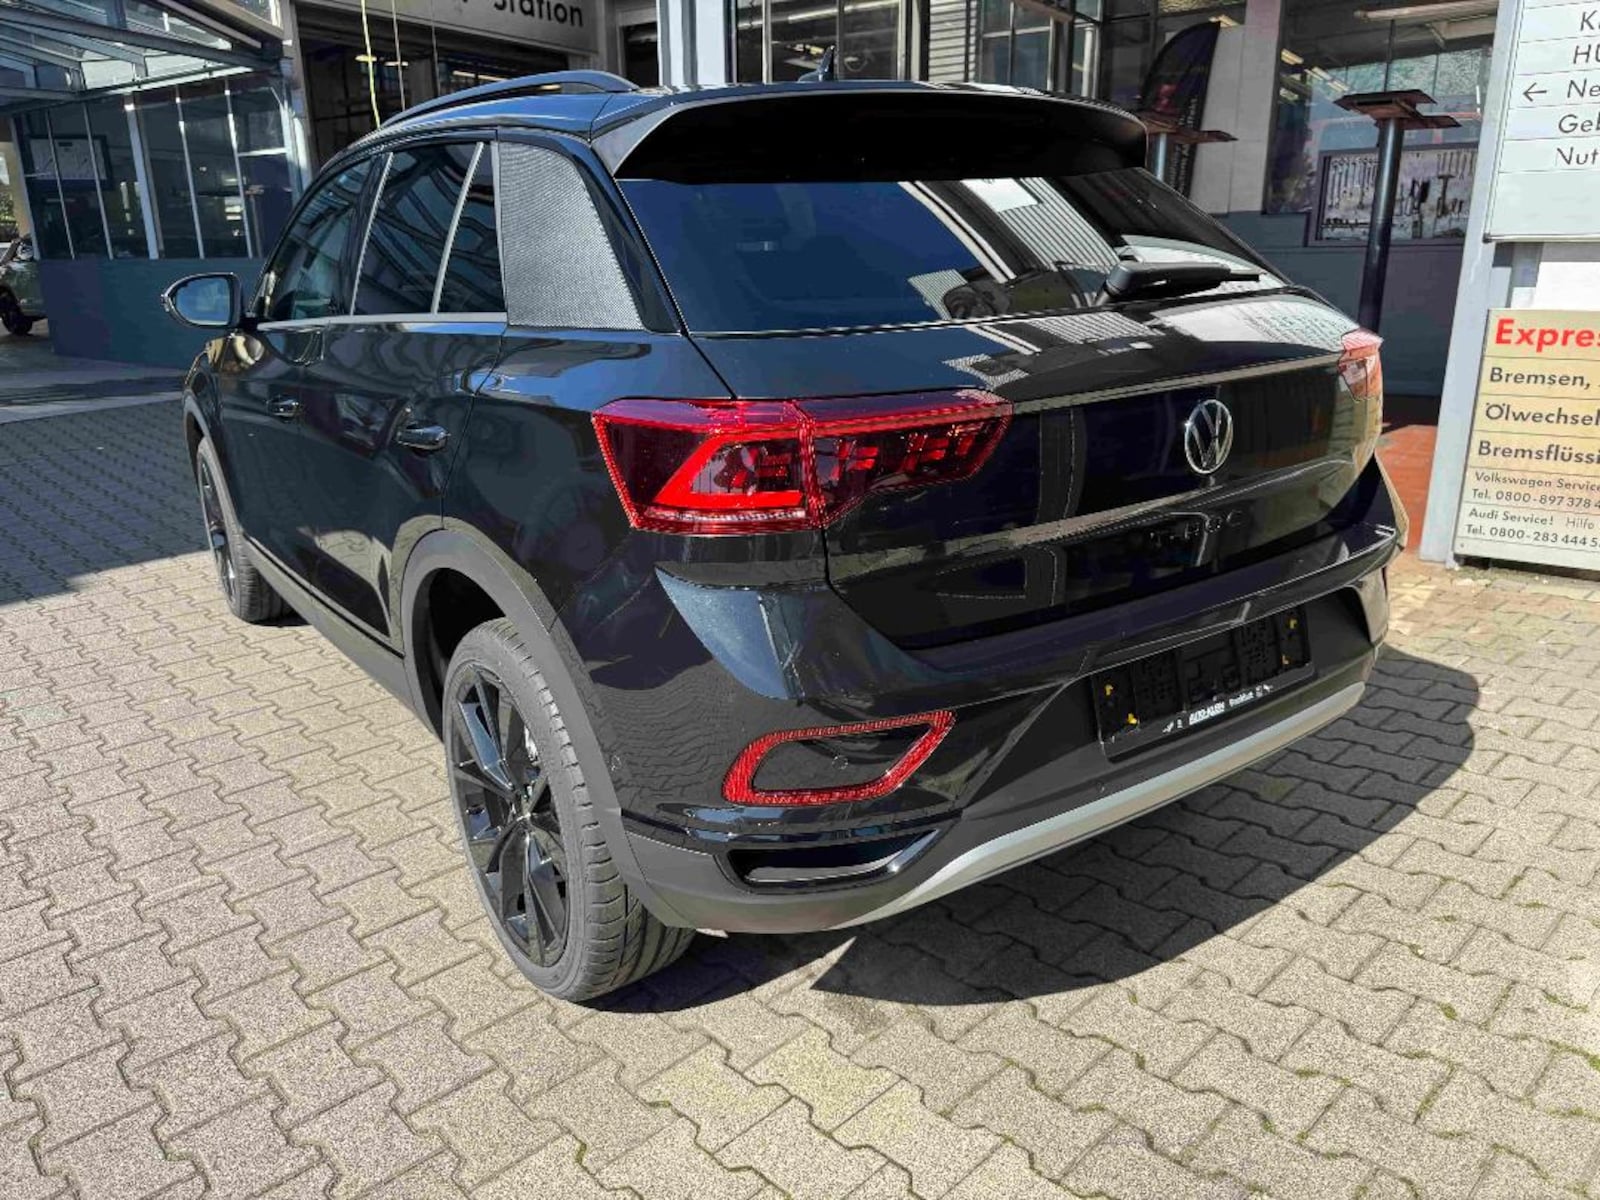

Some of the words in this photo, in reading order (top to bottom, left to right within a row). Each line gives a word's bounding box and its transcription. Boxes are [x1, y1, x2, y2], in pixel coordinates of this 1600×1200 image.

[1580, 10, 1600, 31] K
[1494, 318, 1600, 352] Expre
[1489, 366, 1591, 390] Bremsen,
[1475, 471, 1552, 488] Volkswagen
[1472, 488, 1491, 500] Tel.
[1468, 508, 1499, 520] Audi
[1502, 510, 1554, 526] Service!
[1465, 524, 1486, 536] Tel.
